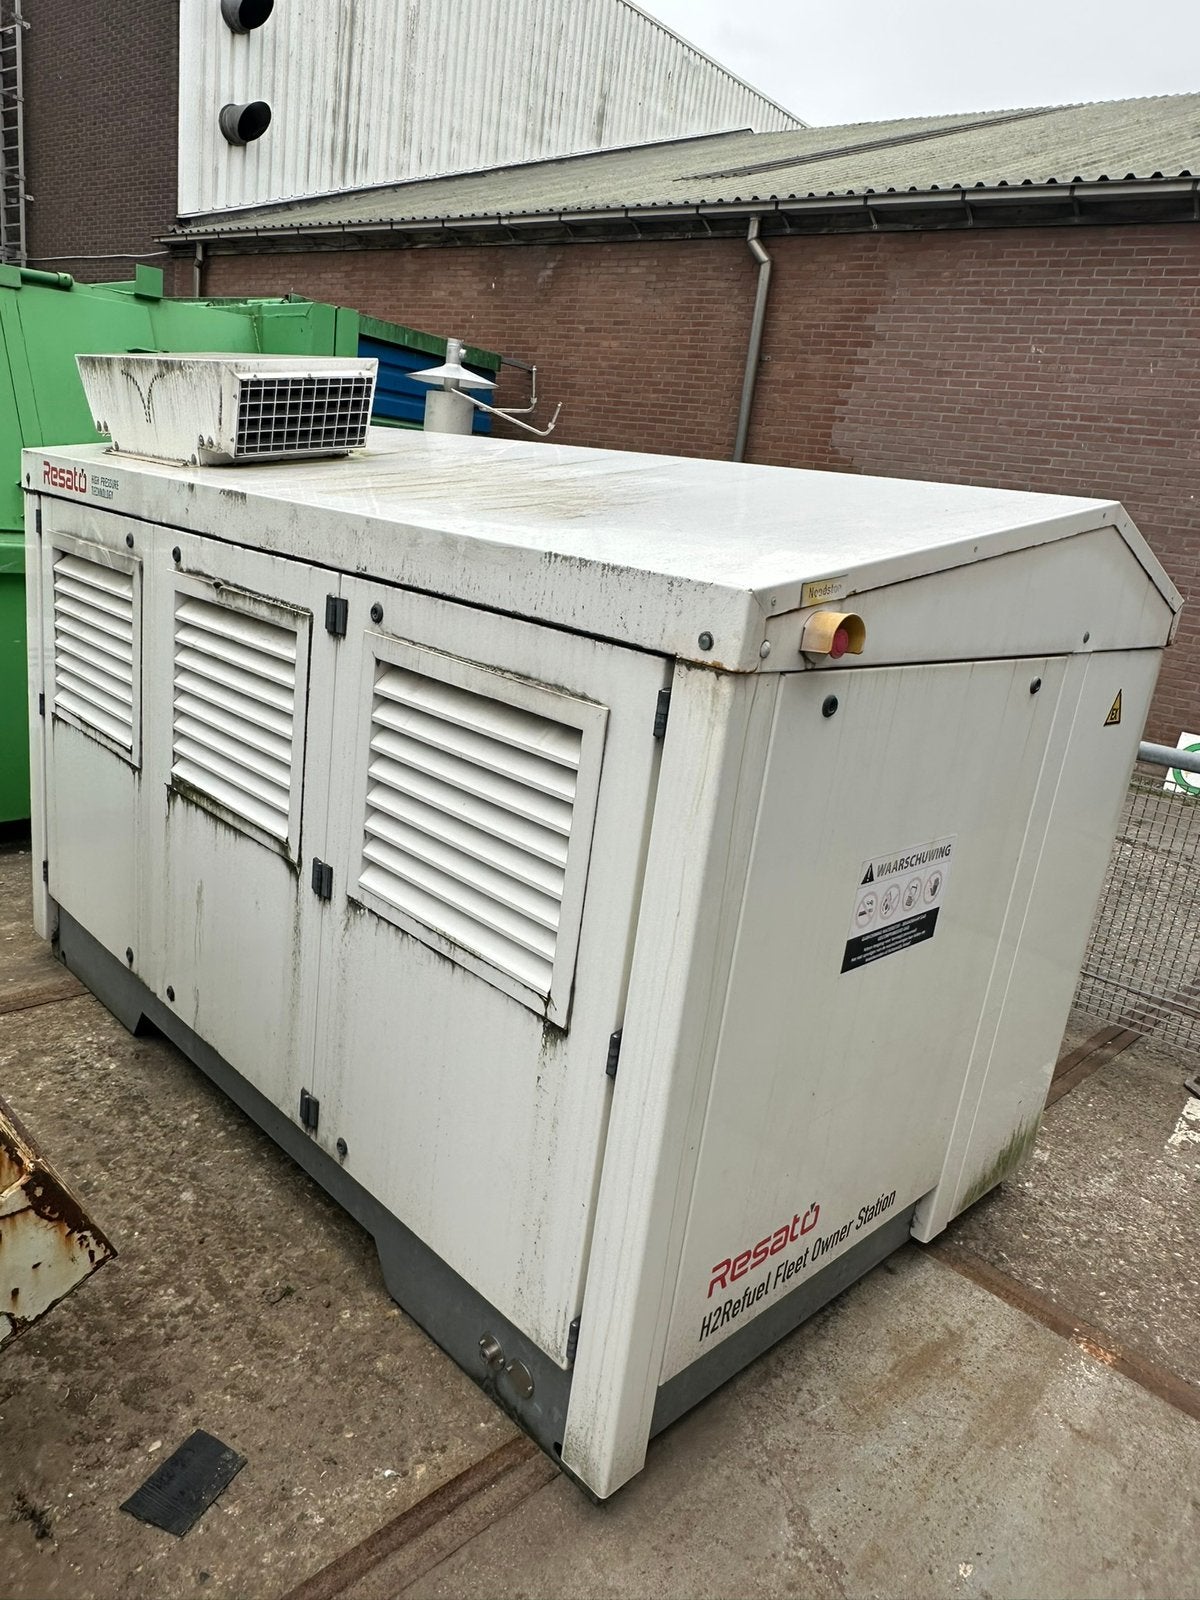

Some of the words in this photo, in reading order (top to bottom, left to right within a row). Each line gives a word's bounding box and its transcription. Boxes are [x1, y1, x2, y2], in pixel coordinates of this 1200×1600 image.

[43, 460, 87, 494] Resato
[876, 844, 952, 878] WAARSCHUWING
[699, 1271, 771, 1342] H2Refuel
[773, 1247, 810, 1290] Fleet
[811, 1219, 855, 1262] Owner
[855, 1190, 897, 1231] Station
[707, 1201, 820, 1299] Resato
